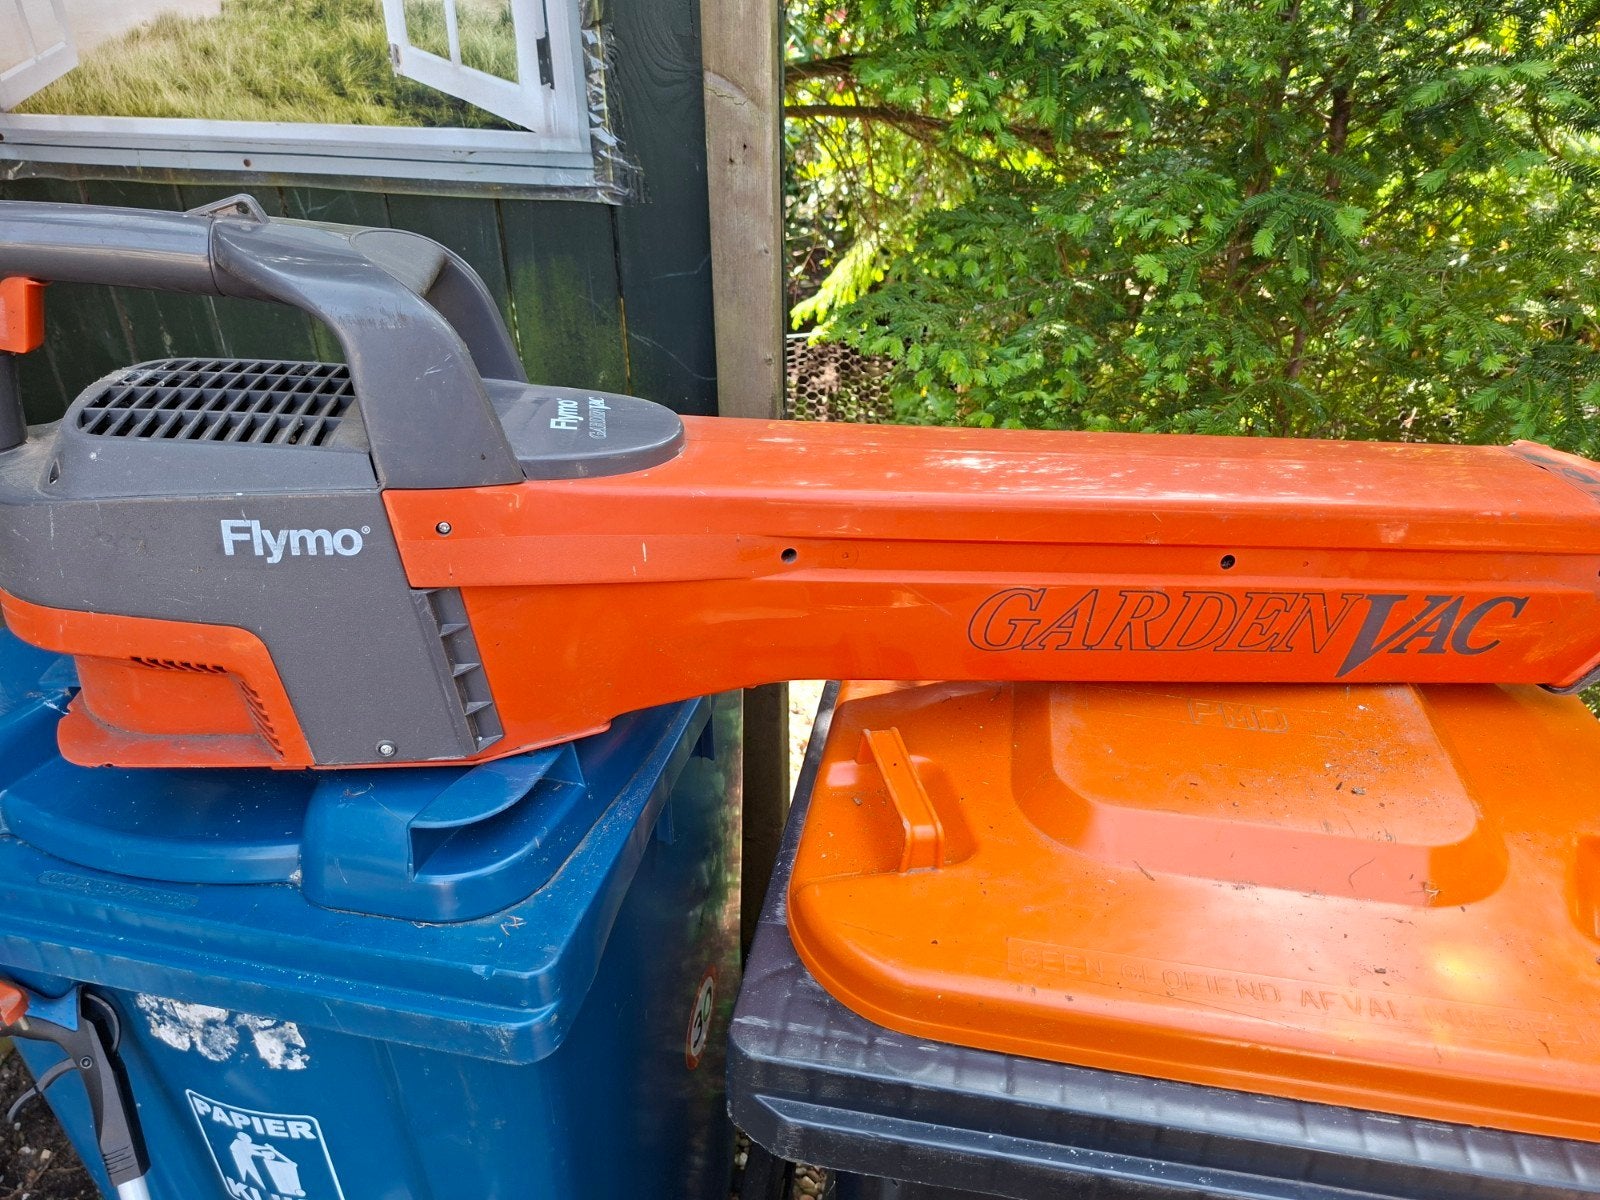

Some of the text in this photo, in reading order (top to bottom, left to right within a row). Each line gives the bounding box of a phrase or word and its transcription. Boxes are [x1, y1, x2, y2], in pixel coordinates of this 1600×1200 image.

[549, 398, 584, 430] Flymo
[220, 519, 364, 564] Flymo
[1187, 699, 1289, 734] PMD
[1020, 947, 1104, 979] GEEN
[693, 985, 713, 1049] 30
[192, 1096, 317, 1140] PAPIER
